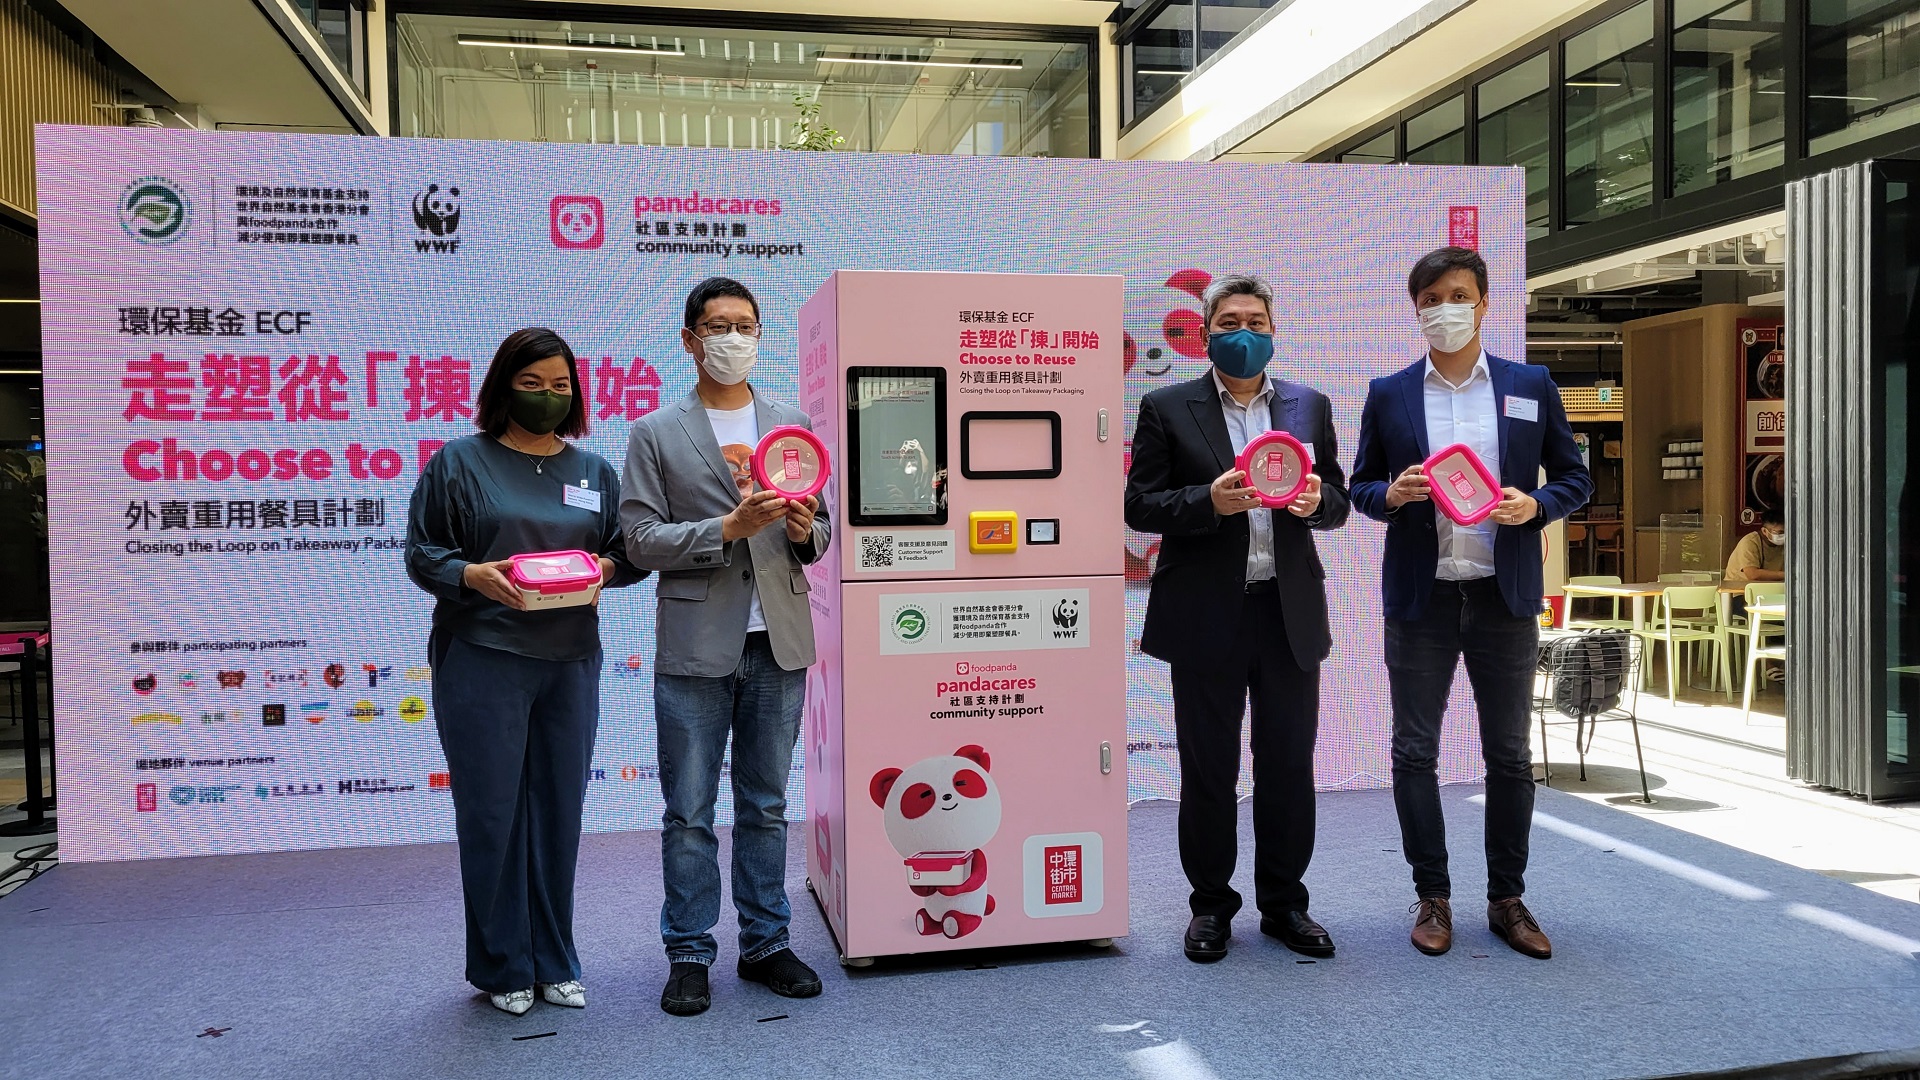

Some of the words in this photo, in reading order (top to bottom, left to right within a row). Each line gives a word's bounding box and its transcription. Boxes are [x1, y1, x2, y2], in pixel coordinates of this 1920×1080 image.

[635, 191, 781, 218] pandacares
[636, 221, 747, 238] 社區支持計劃
[415, 240, 460, 254] WWF
[636, 239, 732, 258] community
[737, 242, 803, 260] support
[119, 308, 246, 335] 環保基金
[256, 312, 311, 334] ECF
[959, 311, 1009, 323] 環保基金
[1012, 312, 1034, 323] ECF
[959, 329, 1099, 349] 走塑從「揀」開始
[959, 353, 1012, 365] Choose
[1015, 354, 1030, 365] to
[1034, 354, 1076, 365] Reuse
[959, 371, 1062, 384] 外賣重用餐具計劃
[959, 387, 982, 395] Closing
[995, 387, 1011, 395] Loop
[1021, 387, 1051, 395] Takeaway
[1053, 387, 1085, 395] Packaging
[122, 438, 333, 482] Choose
[345, 443, 403, 480] to
[124, 498, 385, 530] 外賣重用餐具計劃
[126, 540, 183, 556] Closing
[188, 539, 213, 552] the
[218, 539, 256, 555] Loop
[261, 541, 280, 551] on
[284, 537, 360, 553] Takeaway
[364, 537, 406, 550] Packa
[953, 605, 1023, 613] 世界自然基金會香港分會
[953, 613, 1030, 621] 獲環境及自然保育基金支持
[953, 622, 1007, 630] 與foodpanda合作
[1053, 631, 1078, 639] WWF
[184, 640, 255, 653] participating
[259, 639, 307, 650] partners
[971, 663, 1017, 674] foodpanda
[937, 676, 1036, 697] pandacares
[950, 694, 1025, 706] 社區支持計劃
[930, 707, 995, 719] community
[998, 705, 1044, 718] support
[1126, 741, 1152, 754] gate
[189, 758, 223, 767] venue
[228, 756, 276, 768] partners
[1050, 850, 1077, 868] 中環
[1050, 867, 1077, 885] 街市
[1051, 884, 1077, 892] CENTRAL
[1051, 891, 1077, 899] MARKET
